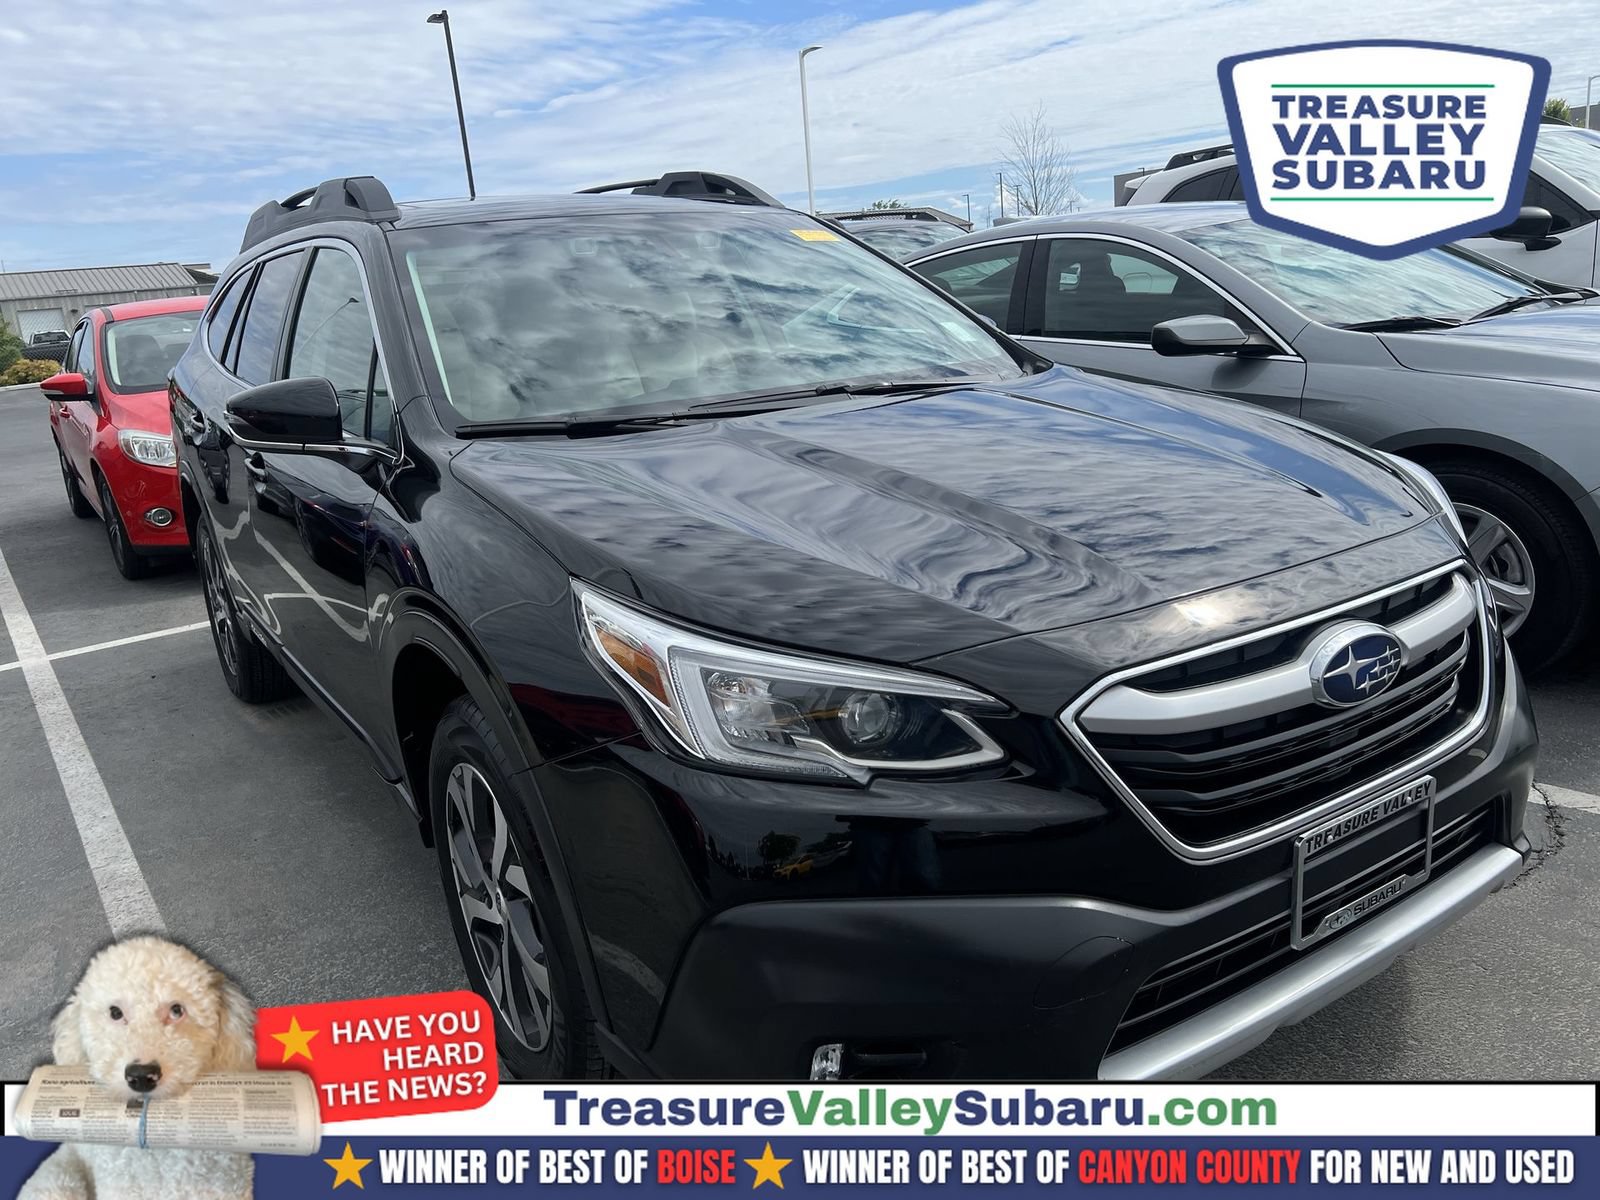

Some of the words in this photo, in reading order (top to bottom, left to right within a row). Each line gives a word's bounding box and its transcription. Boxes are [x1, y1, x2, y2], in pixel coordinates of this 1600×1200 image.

[1305, 808, 1379, 854] TREASURE
[1383, 780, 1431, 815] VALLEY
[1354, 881, 1402, 916] SUBARU
